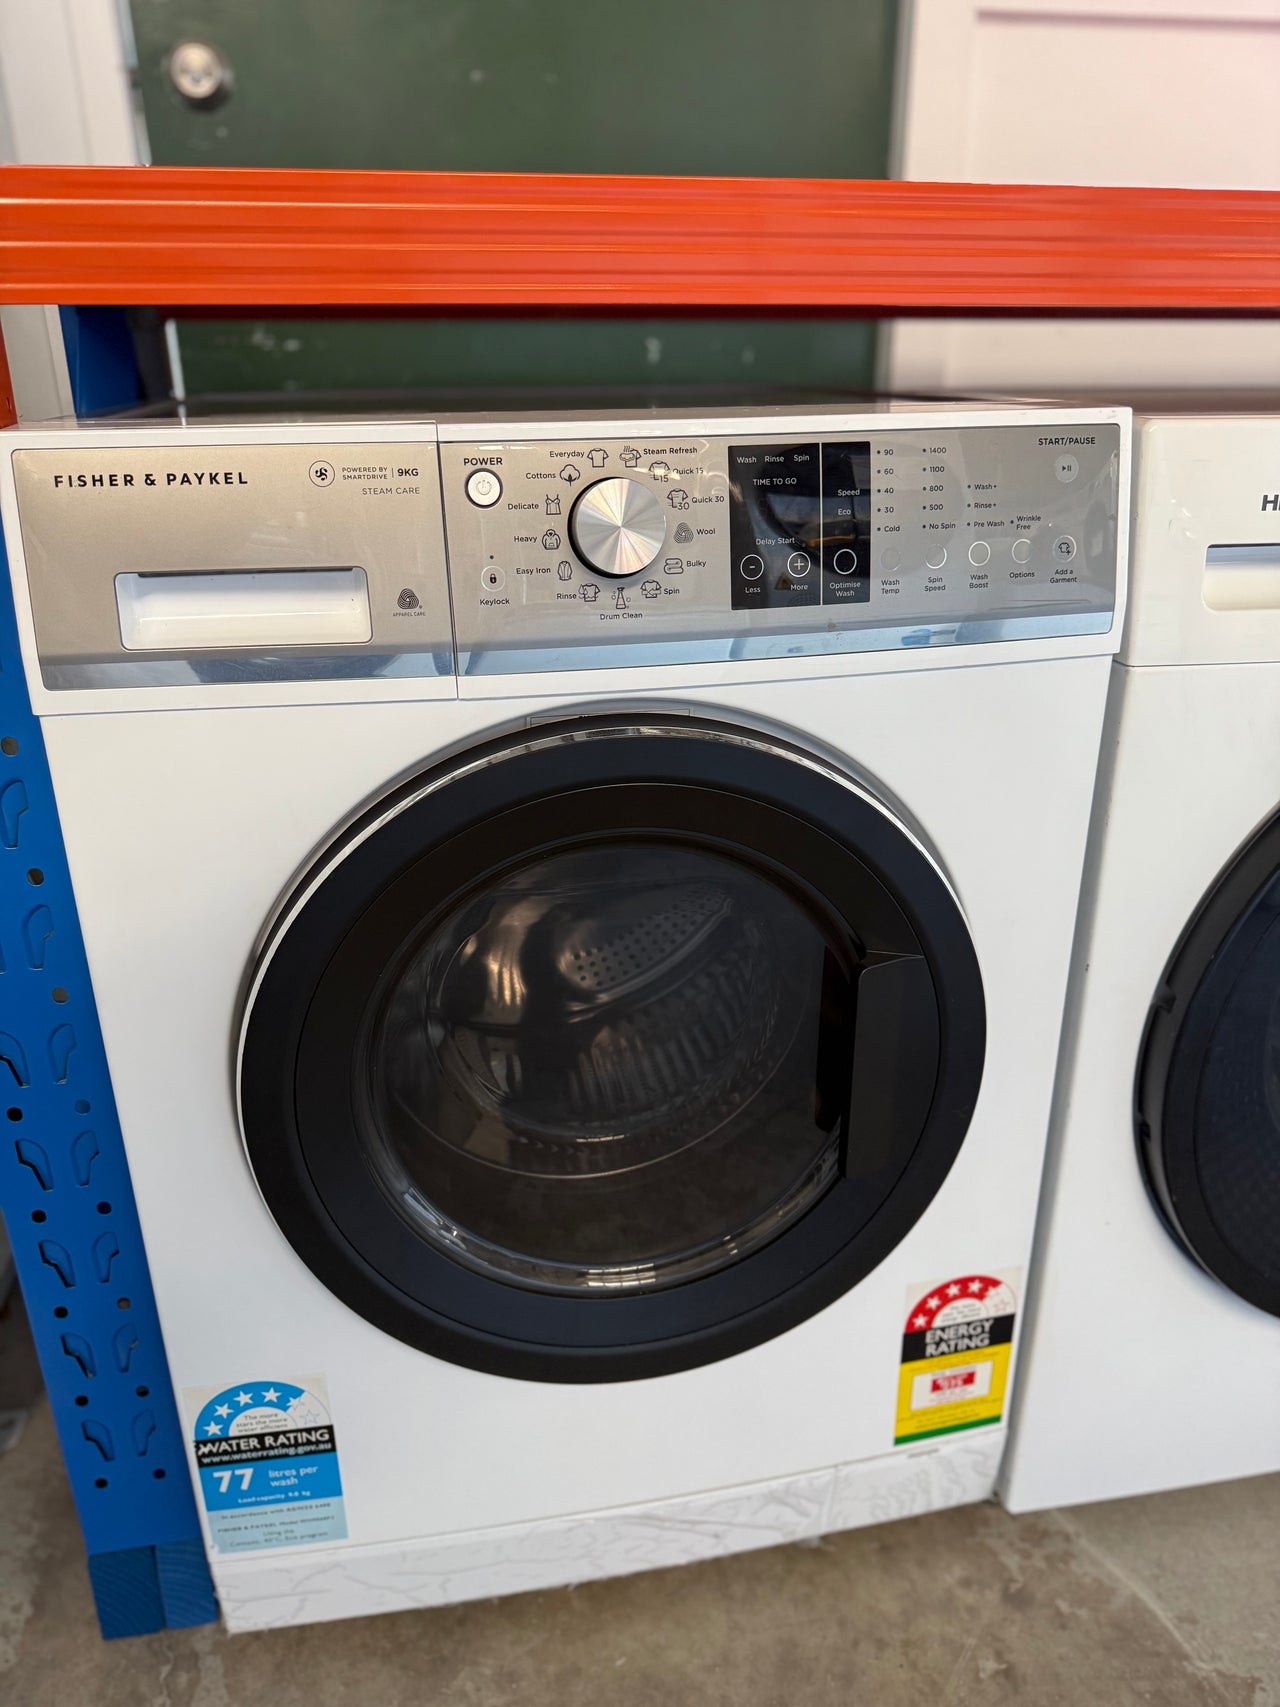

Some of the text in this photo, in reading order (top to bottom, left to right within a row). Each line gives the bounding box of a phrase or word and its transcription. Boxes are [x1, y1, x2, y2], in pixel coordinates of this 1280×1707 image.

[1038, 437, 1096, 446] START/PAUSE
[550, 450, 585, 459] Everyday
[643, 446, 697, 455] Steam Refresh
[464, 457, 503, 466] POWER
[736, 456, 757, 464] Wash
[793, 454, 810, 462] Spin
[397, 468, 419, 477] 9KG
[672, 467, 694, 475] Quick
[54, 472, 248, 488] FISHER & PAYKEL
[362, 487, 393, 495] STEAM
[837, 489, 860, 497] Speed
[692, 495, 725, 503] Quick 30
[1261, 494, 1280, 511] H
[507, 502, 539, 510] Delicate
[940, 522, 956, 530] Spin
[514, 535, 537, 544] Heavy
[755, 538, 776, 546] Delay
[686, 559, 706, 567] Bulky
[516, 567, 532, 575] Easy
[1009, 571, 1035, 579] Options
[927, 576, 943, 584] Spin
[663, 587, 680, 595] Spin
[924, 585, 946, 593] Speed
[557, 592, 577, 600] Rinse
[480, 598, 510, 606] Keylock
[925, 1318, 994, 1344] ENERGY
[925, 1334, 990, 1357] RATING
[198, 1429, 330, 1454] WATER RATING
[201, 1442, 332, 1463] www.waterrating.gov.au
[268, 1466, 318, 1477] litres per
[212, 1468, 254, 1493] 77
[270, 1477, 298, 1487] wash
